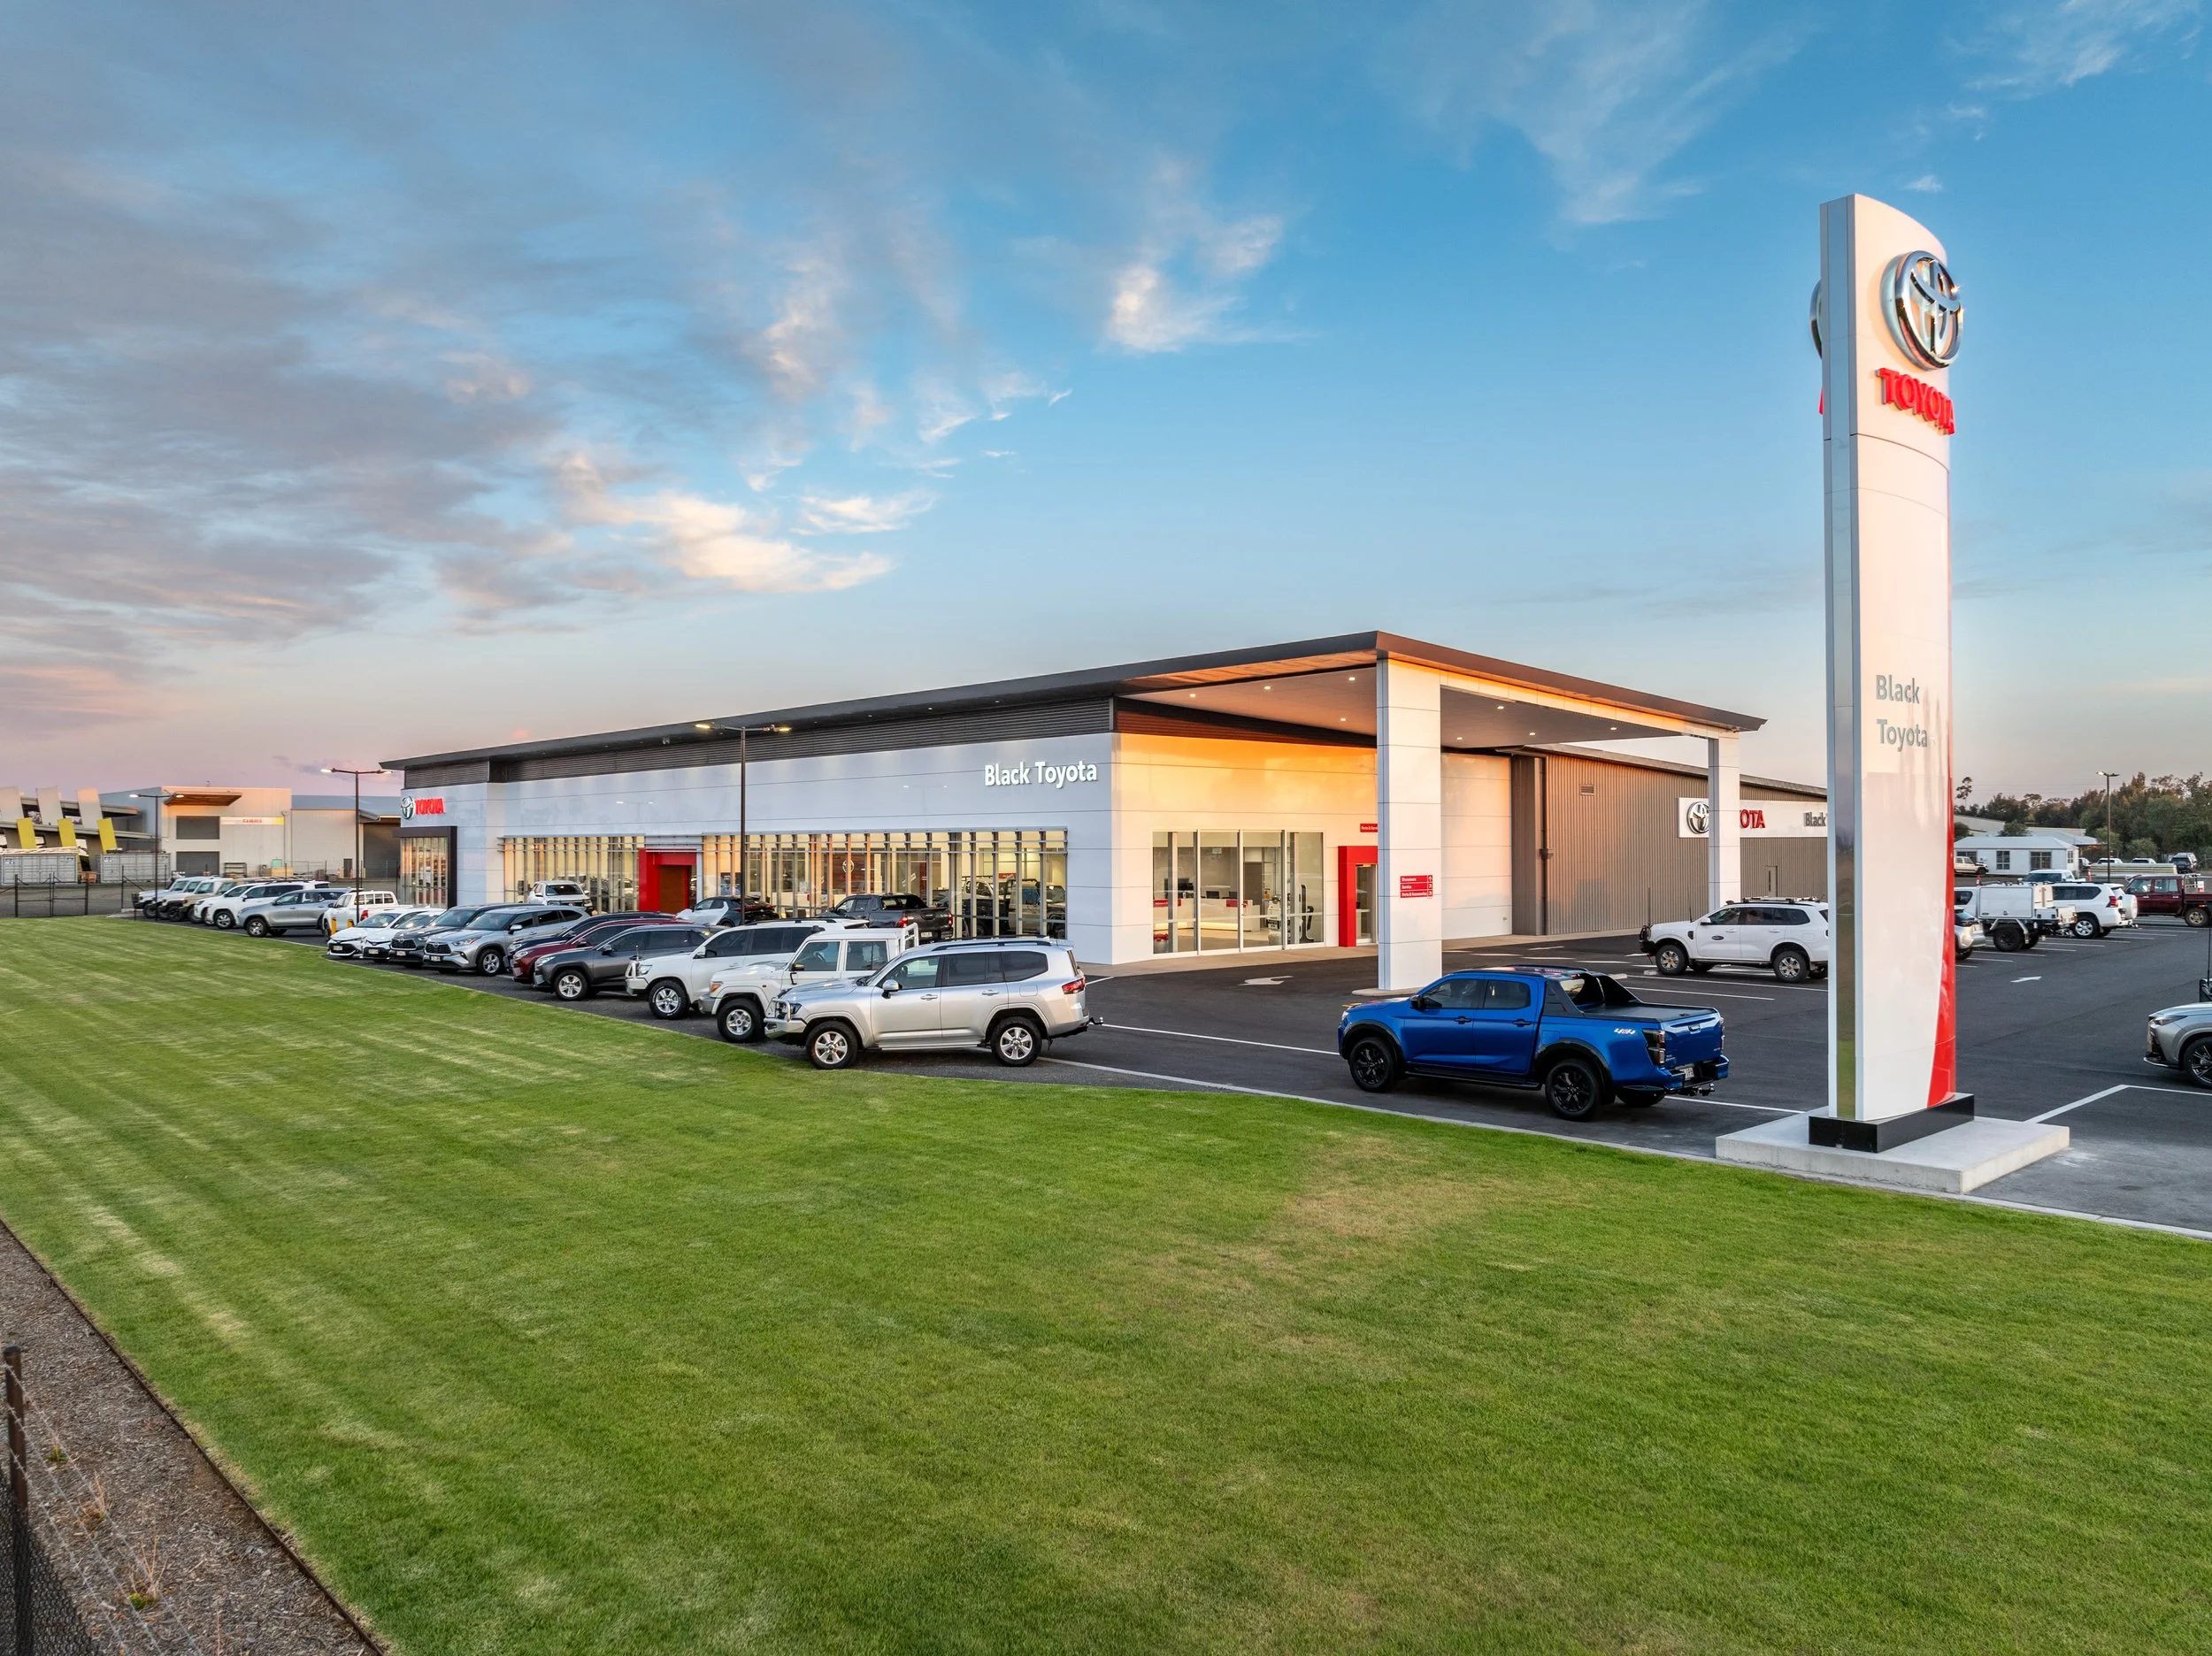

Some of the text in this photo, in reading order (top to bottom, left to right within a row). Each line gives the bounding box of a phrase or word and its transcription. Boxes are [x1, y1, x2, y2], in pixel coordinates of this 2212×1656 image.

[1875, 367, 1955, 435] TOYOTA
[1876, 674, 1920, 704] Black
[1876, 718, 1928, 752] Toyota
[985, 760, 1098, 789] Black Toyota
[414, 797, 444, 815] TOYOTA
[1740, 809, 1766, 829] OTA
[1803, 811, 1827, 827] Black
